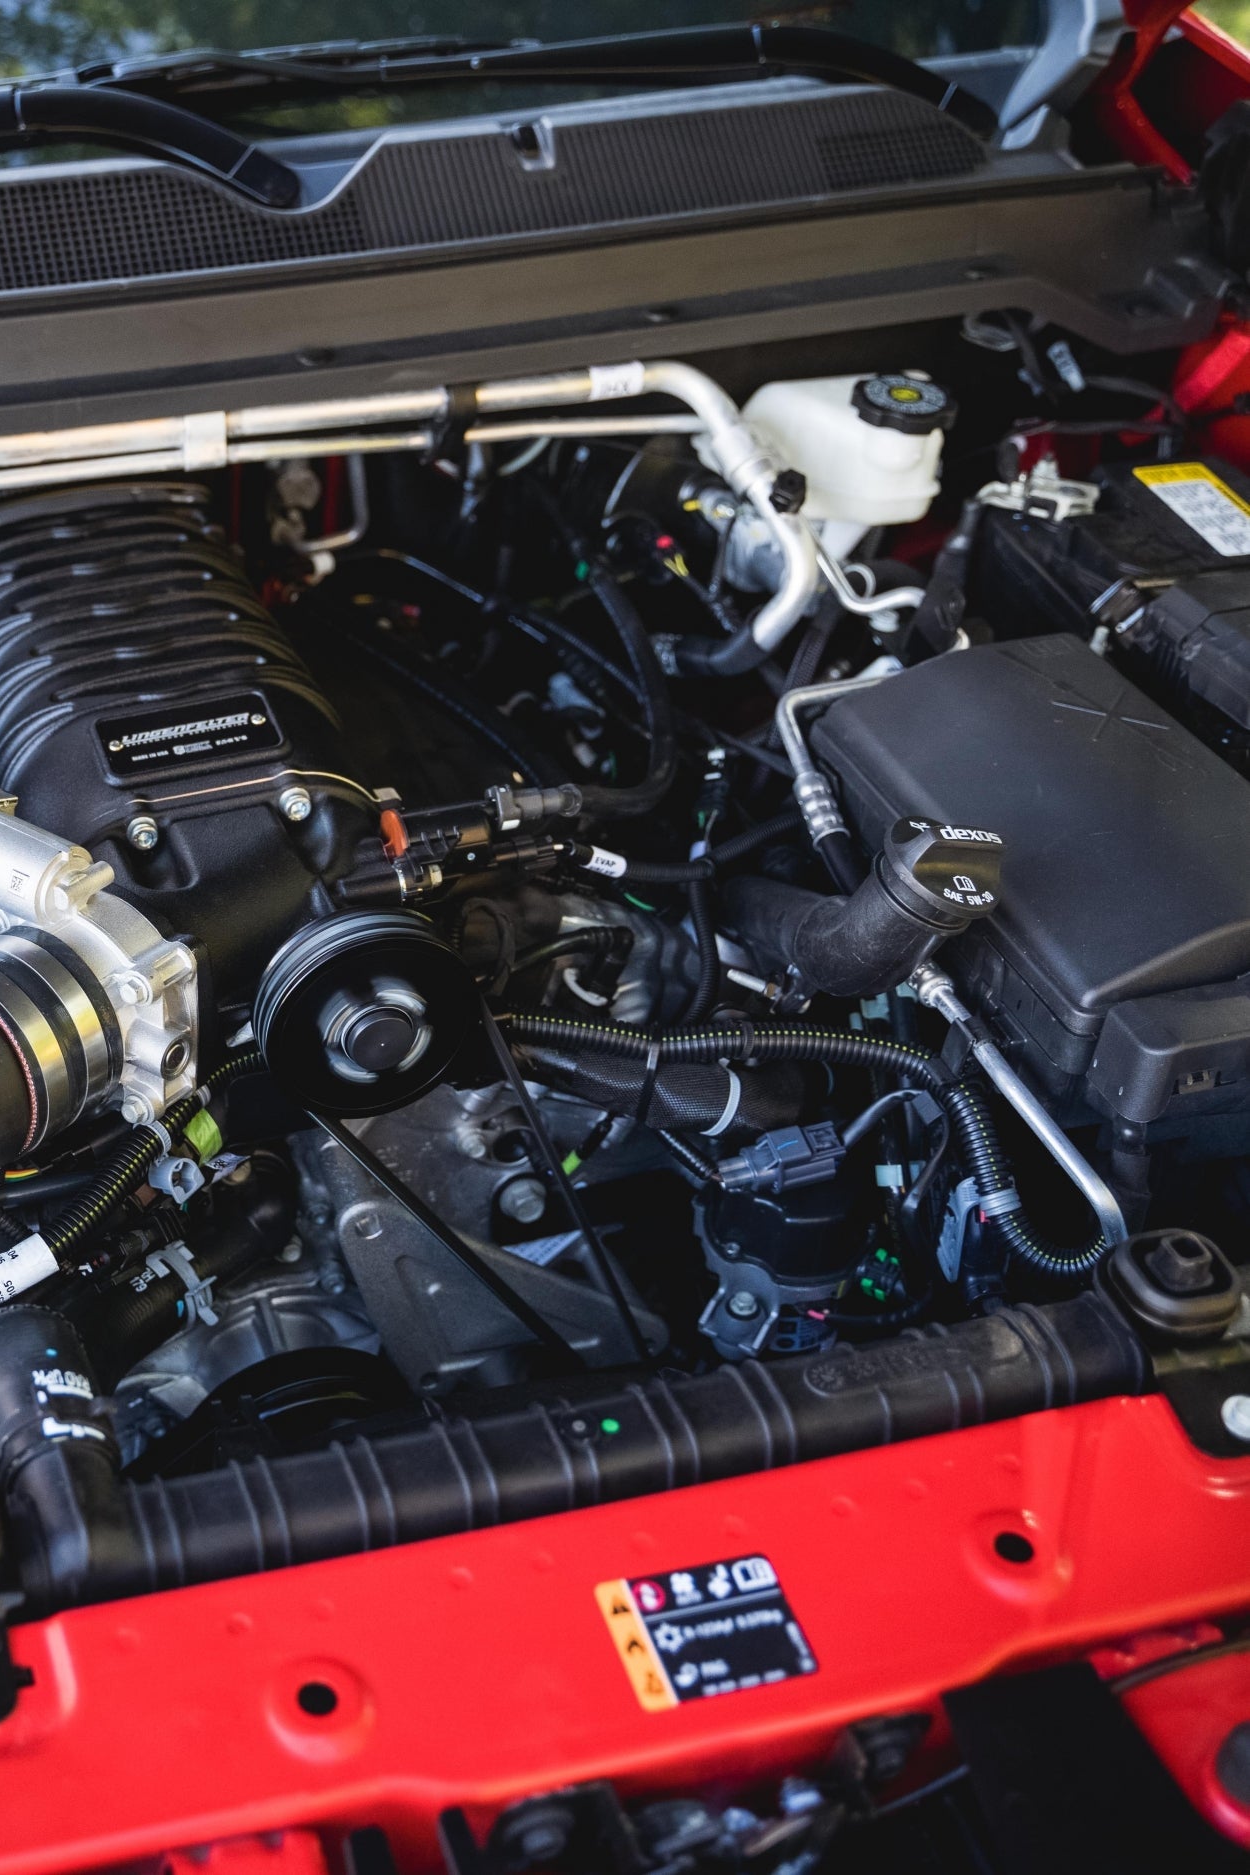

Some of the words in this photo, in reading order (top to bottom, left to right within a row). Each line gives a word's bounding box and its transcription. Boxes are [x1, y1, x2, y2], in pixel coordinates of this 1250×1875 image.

[122, 712, 249, 743] LINGENFELTER
[940, 826, 1002, 844] dexos
[595, 856, 617, 868] EVAP
[943, 888, 964, 903] SAE
[966, 891, 994, 905] 5W-30
